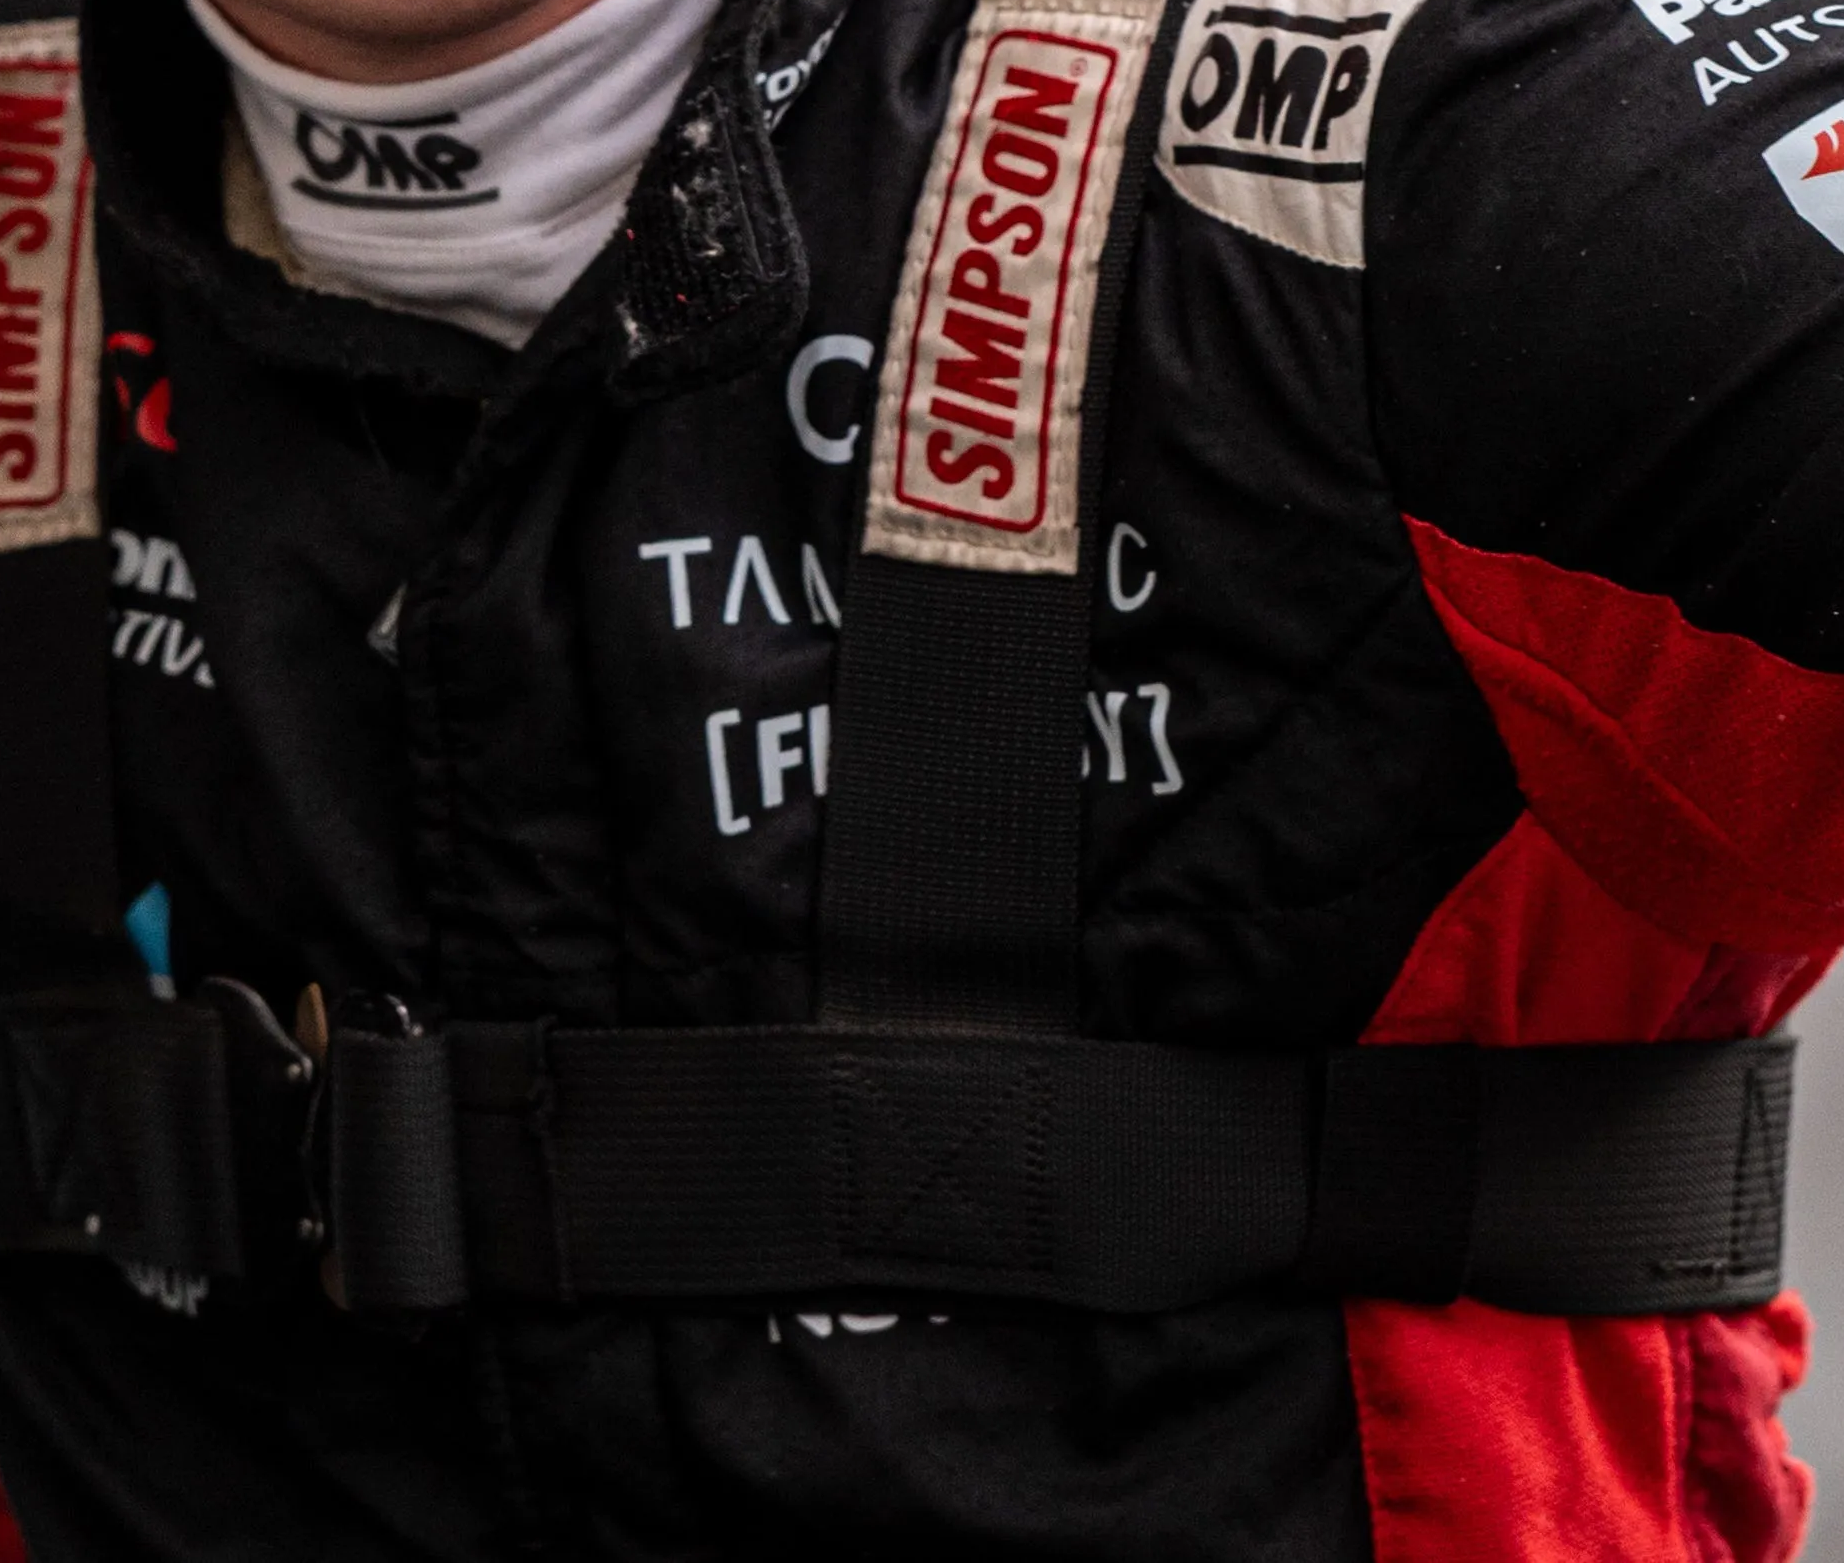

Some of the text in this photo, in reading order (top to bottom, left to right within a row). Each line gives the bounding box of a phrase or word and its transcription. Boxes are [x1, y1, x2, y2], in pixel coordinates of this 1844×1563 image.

[1180, 32, 1371, 150] OMP
[295, 111, 482, 191] OMP
[925, 65, 1081, 501] SIMPSON
